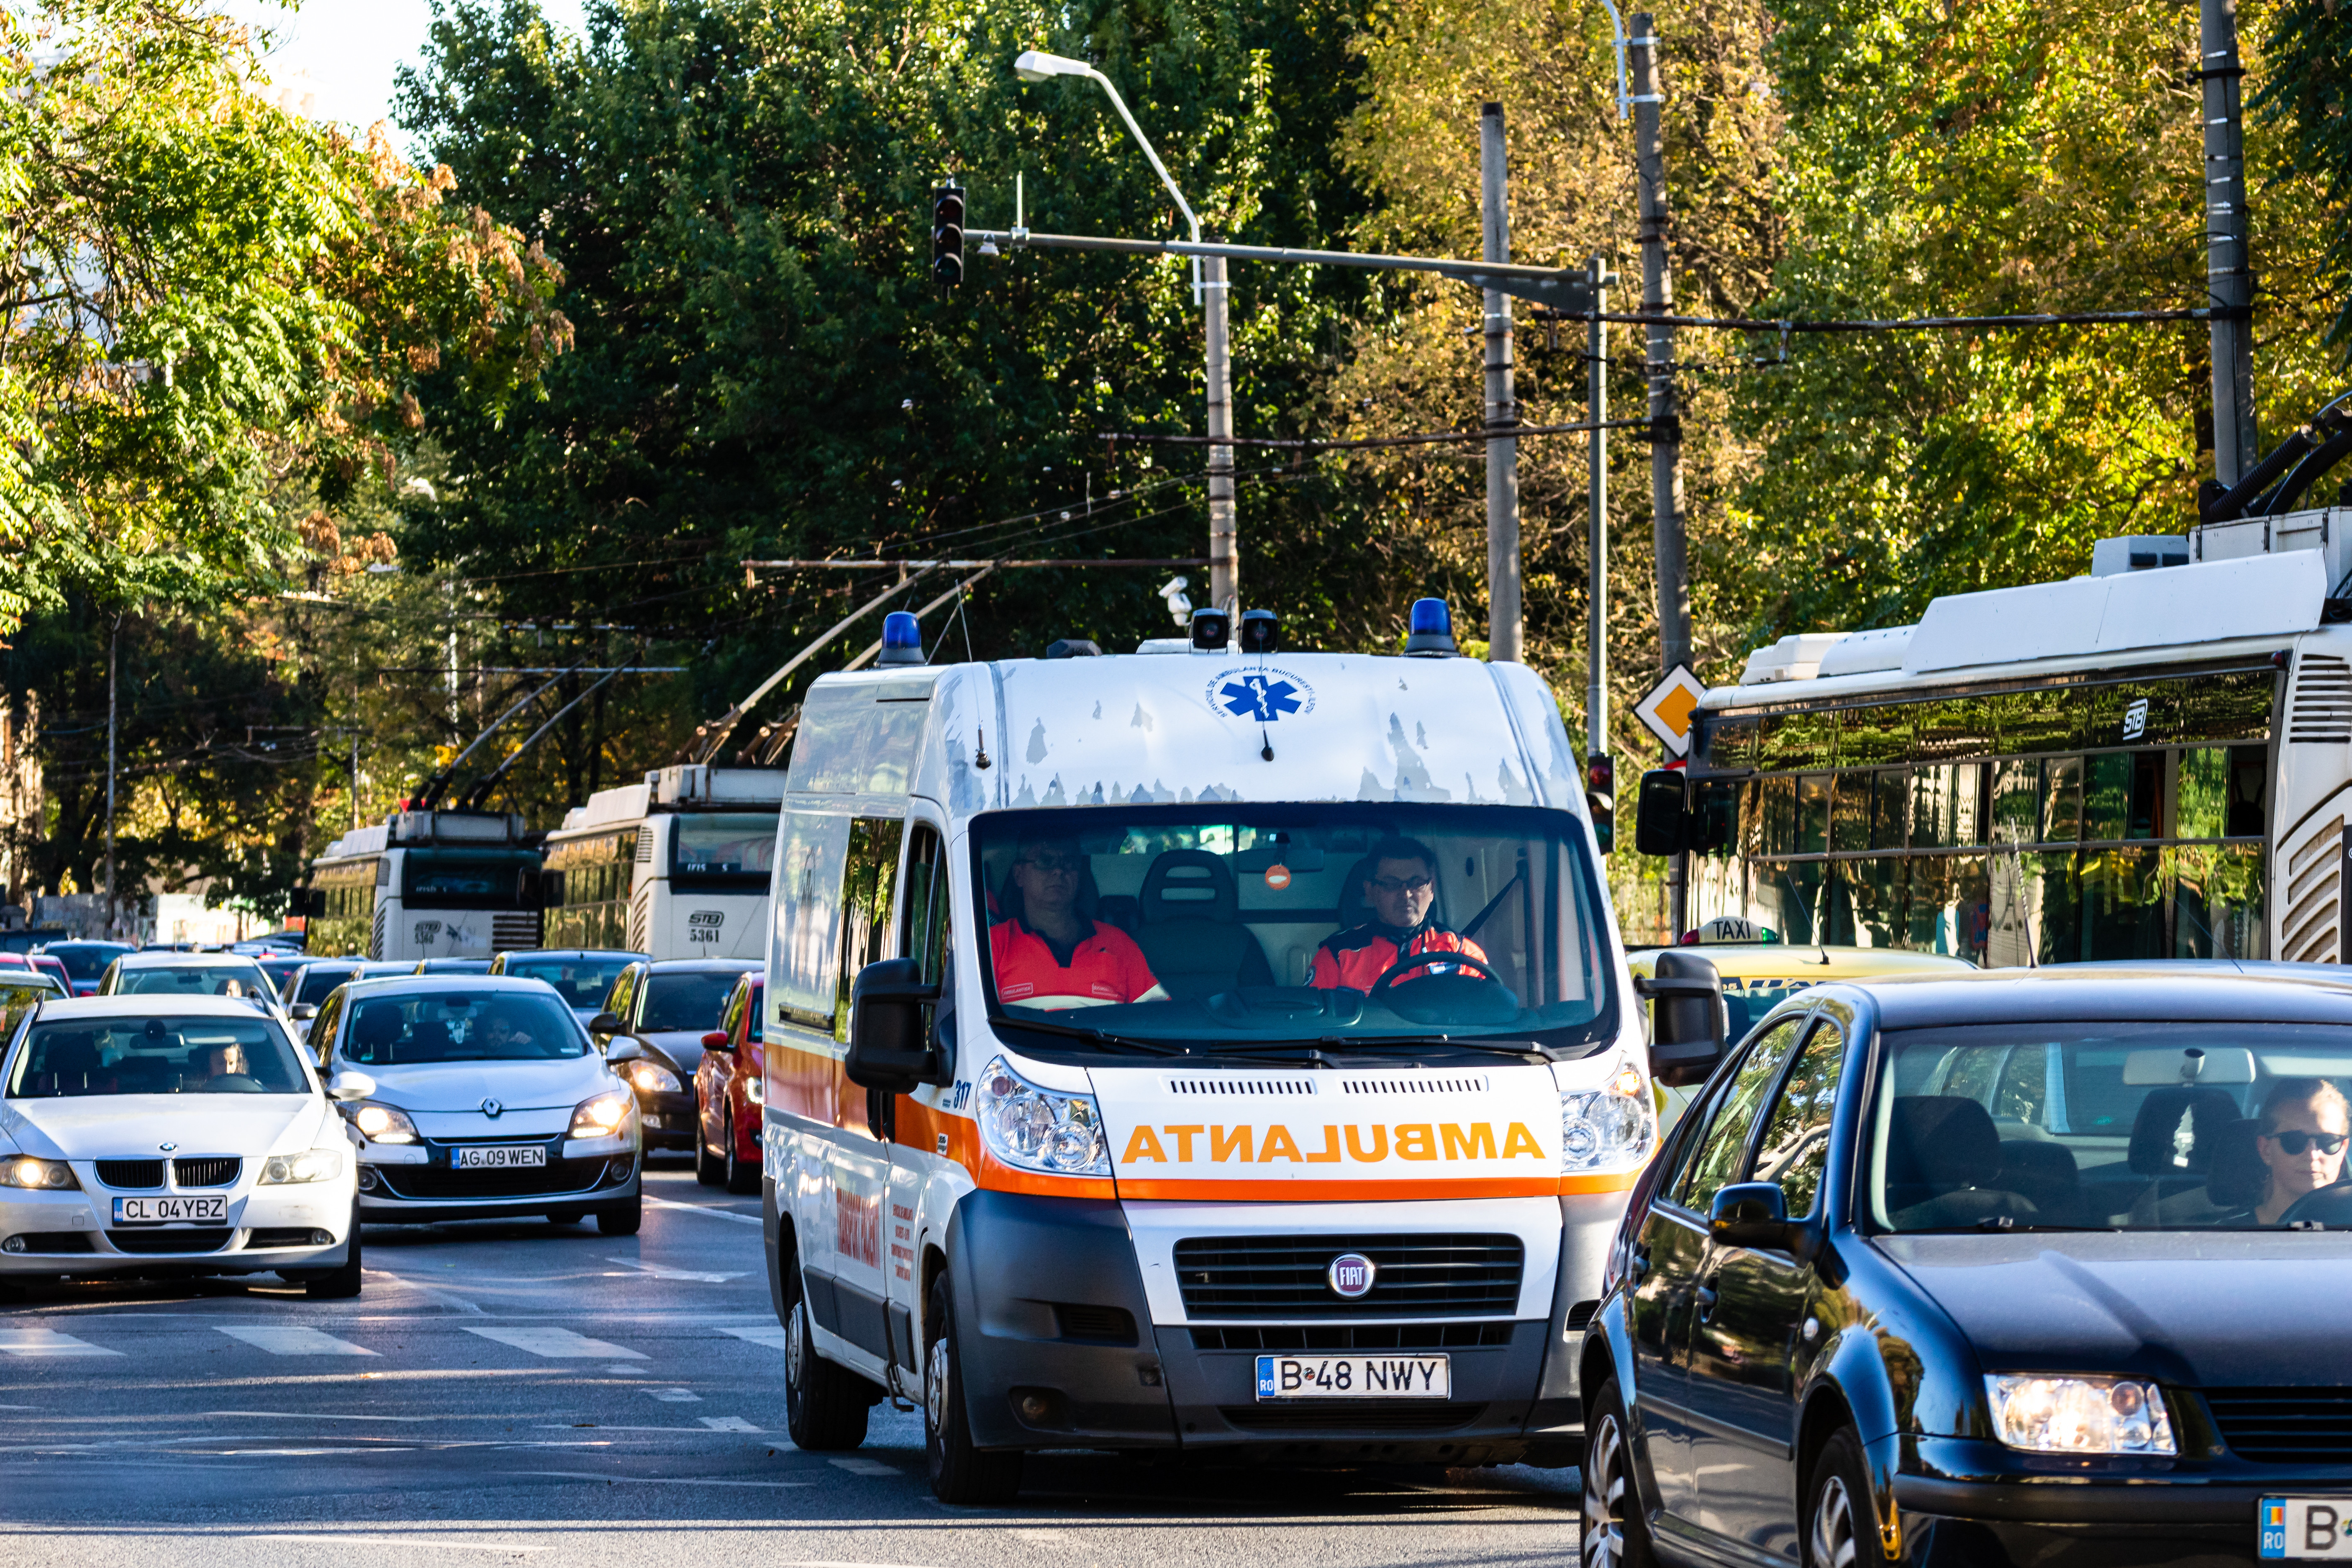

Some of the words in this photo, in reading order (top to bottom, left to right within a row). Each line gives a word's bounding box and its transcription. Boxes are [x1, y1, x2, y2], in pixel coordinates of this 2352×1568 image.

[2123, 706, 2145, 734] STB
[689, 914, 720, 924] STB
[690, 929, 719, 943] 5361
[1713, 921, 1751, 940] TAXI
[953, 1079, 972, 1111] 317
[460, 1151, 481, 1166] AG
[487, 1150, 505, 1165] 09
[508, 1149, 544, 1165] WEN
[126, 1200, 151, 1218] CL
[158, 1199, 180, 1218] 04
[183, 1199, 223, 1218] YBZ
[1339, 1267, 1364, 1286] FIAT
[1280, 1360, 1302, 1390] B
[1316, 1360, 1352, 1390] 48
[1366, 1361, 1437, 1391] NWY
[1259, 1379, 1274, 1392] RO
[2305, 1505, 2339, 1551] B
[2263, 1532, 2284, 1549] RO
